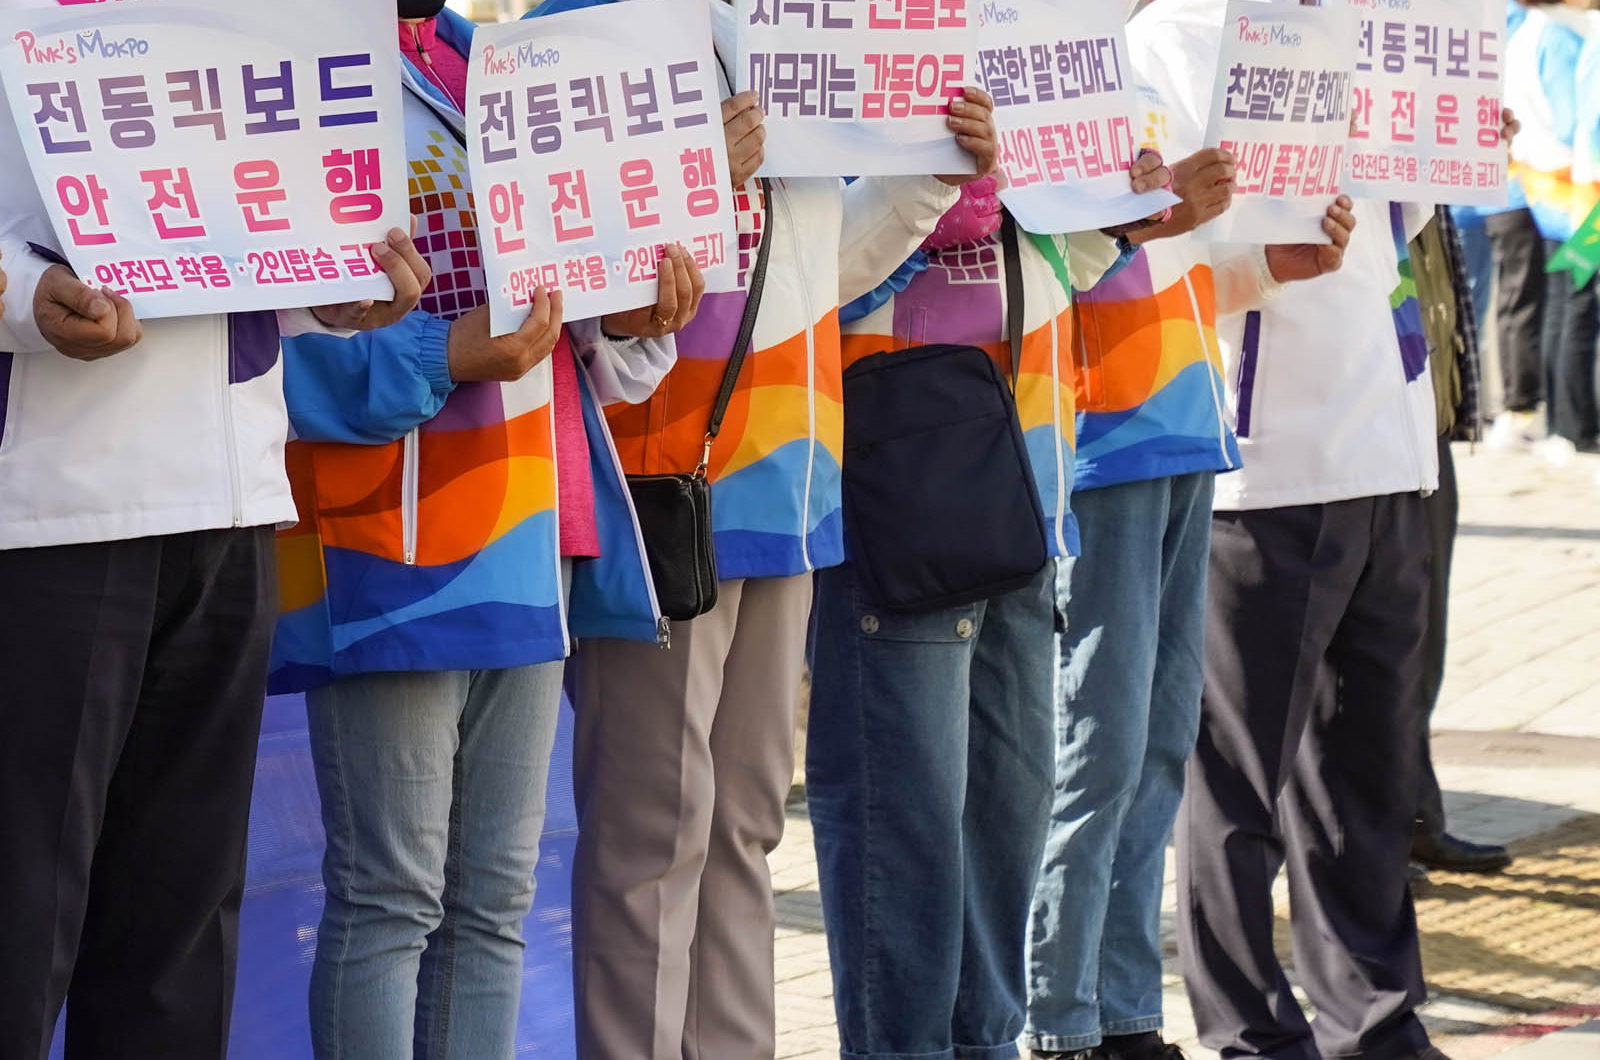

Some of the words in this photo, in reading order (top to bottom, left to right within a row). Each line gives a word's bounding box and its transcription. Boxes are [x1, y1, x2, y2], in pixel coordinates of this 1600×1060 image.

[750, 53, 856, 118] 마무리는
[862, 54, 965, 118] 감동으로
[1030, 44, 1055, 102] 말
[1055, 37, 1123, 100] 한마디
[1224, 62, 1295, 122] 친절한
[1290, 69, 1314, 123] 말
[26, 53, 379, 155] 전동킥보드
[479, 60, 709, 164] 전동킥보드
[996, 127, 1045, 188] 신의
[1352, 154, 1390, 181] 안전모
[1393, 156, 1418, 183] 착용
[1430, 159, 1474, 187] 2인탑승
[1477, 162, 1500, 188] 금지
[95, 258, 178, 295] 안전모
[176, 254, 231, 289] 착용
[248, 245, 340, 285] 2인탑승
[564, 255, 608, 292] 착용
[624, 243, 682, 284] 2인
[692, 232, 725, 269] 금지
